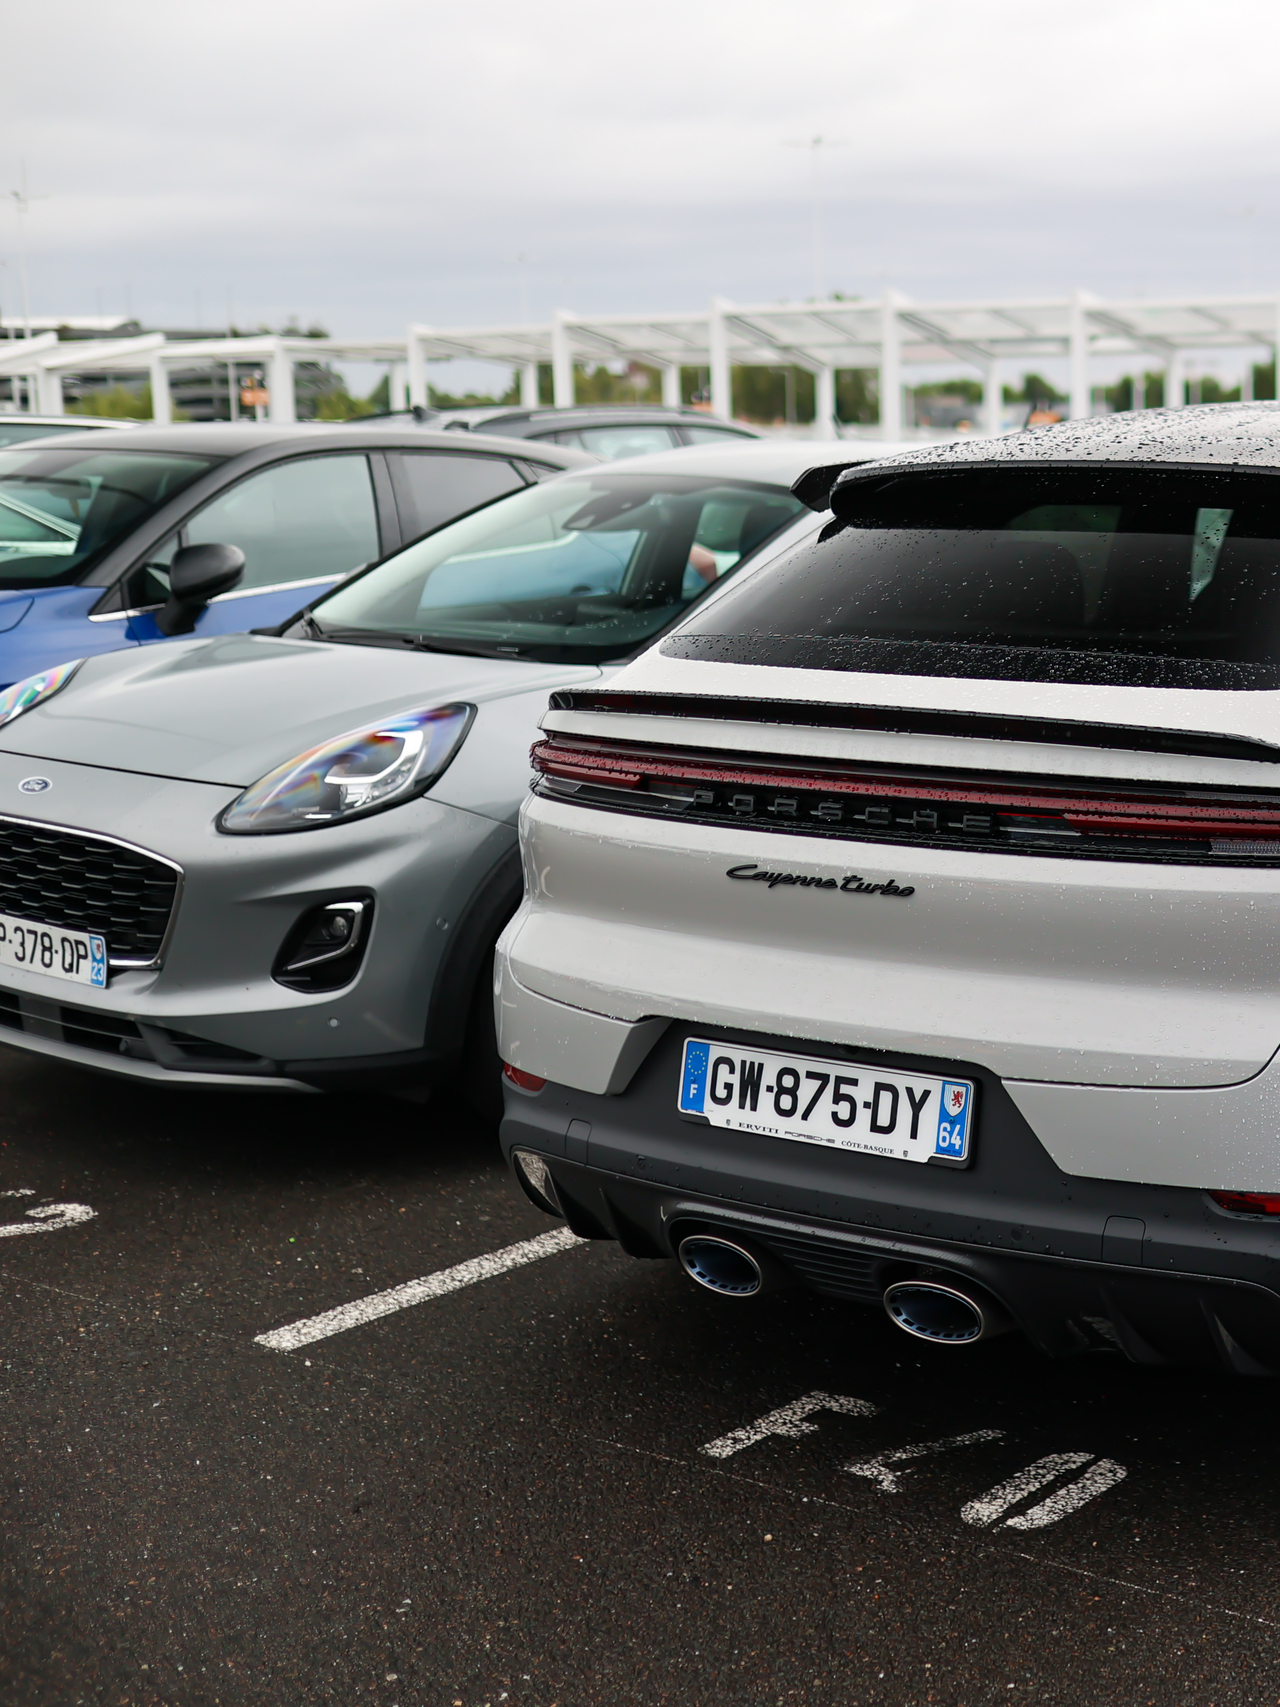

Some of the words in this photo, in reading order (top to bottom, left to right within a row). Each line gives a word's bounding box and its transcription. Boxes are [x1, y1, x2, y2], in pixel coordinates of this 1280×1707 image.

[693, 789, 993, 834] PORSCHE
[726, 864, 838, 889] Cayenne
[840, 875, 915, 897] turbo
[91, 962, 104, 981] 23
[689, 1083, 698, 1099] F
[709, 1056, 932, 1140] GW-875-DY
[738, 1122, 779, 1134] ERVITI
[938, 1122, 962, 1150] 64
